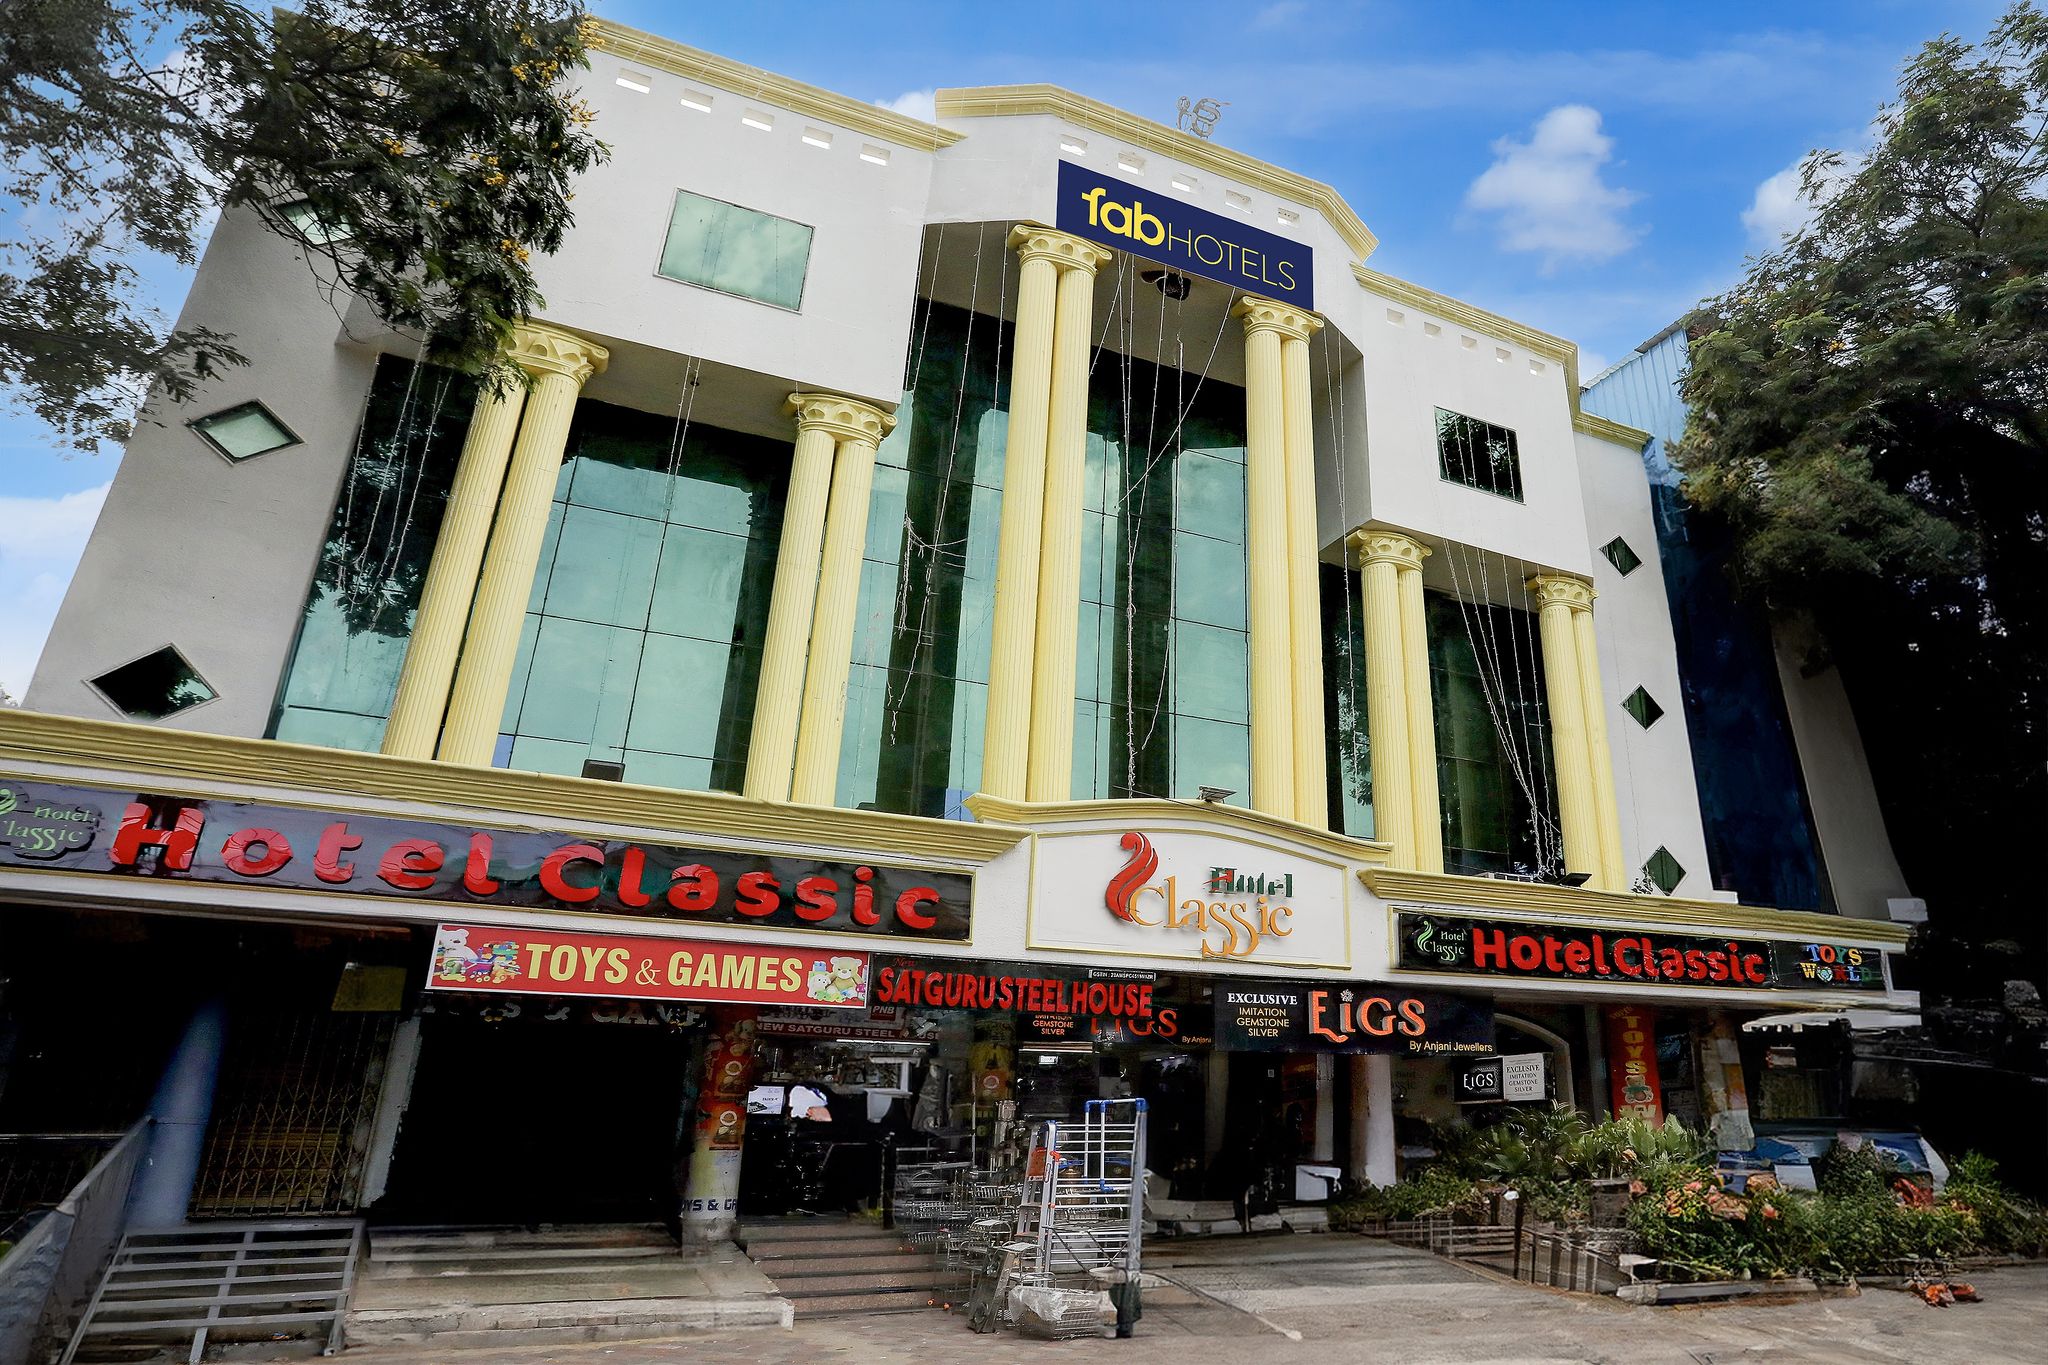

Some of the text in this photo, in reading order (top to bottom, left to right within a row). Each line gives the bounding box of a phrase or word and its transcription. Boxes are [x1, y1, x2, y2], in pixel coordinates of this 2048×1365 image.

[1081, 187, 1297, 292] fab HOTELS
[3, 820, 84, 851] lassic
[109, 802, 943, 930] Hotel Classic
[1129, 875, 1294, 958] Classic
[1441, 930, 1465, 942] Hotel
[1422, 940, 1466, 962] Classic
[1472, 927, 1765, 983] Hotel Classic
[1805, 943, 1863, 966] TOYS
[526, 943, 804, 992] TOYS & GAMES
[877, 966, 1153, 1018] SATGURU STEEL HOUSE
[1227, 992, 1298, 1006] EXCLUSIVE
[872, 1005, 896, 1015] PNB
[1238, 1007, 1287, 1017] IMITATION
[1032, 1019, 1075, 1029] GEMSTONE
[1236, 1017, 1290, 1028] GEMSTONE
[787, 1024, 851, 1036] SATGURU
[854, 1028, 896, 1039] STEEL
[1040, 1027, 1066, 1036] SILVER
[1247, 1028, 1279, 1038] SILVER
[1181, 1036, 1190, 1045] By
[1409, 1041, 1493, 1053] By Anjani Jewellers
[1621, 1015, 1648, 1075] TOYS
[1506, 1064, 1541, 1074] EXCLUSIVE
[1508, 1079, 1538, 1087] GEMSTONE
